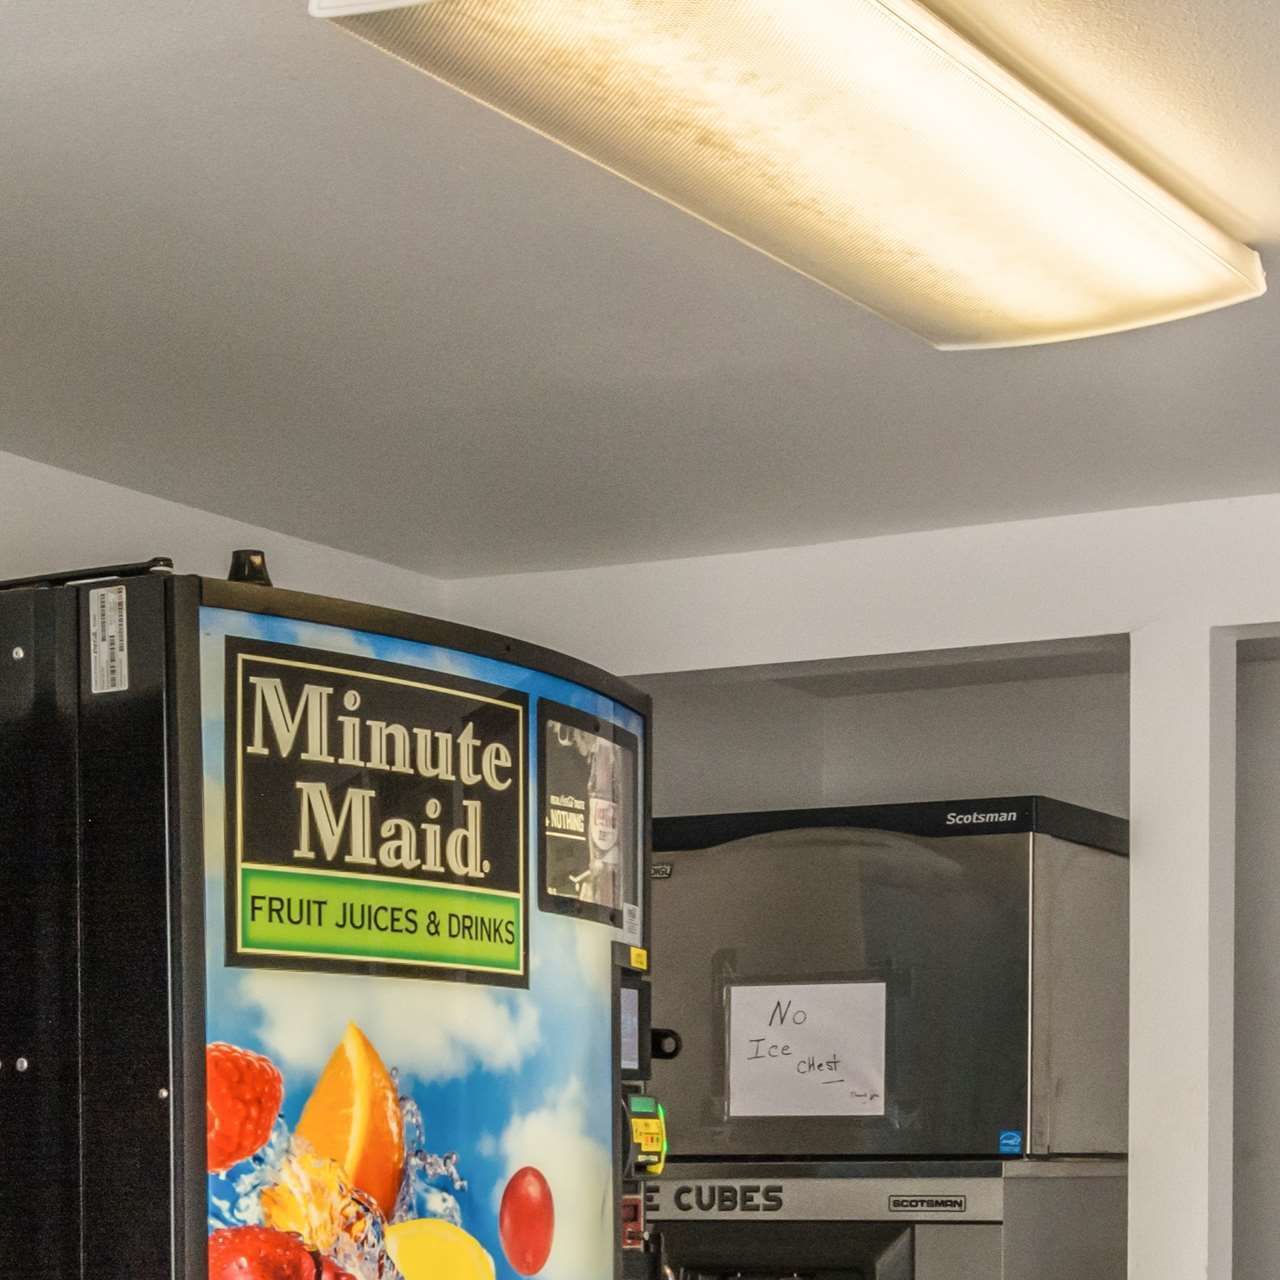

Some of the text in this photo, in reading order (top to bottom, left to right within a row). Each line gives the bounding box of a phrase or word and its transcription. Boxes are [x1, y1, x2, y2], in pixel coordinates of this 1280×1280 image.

[246, 676, 513, 791] Minute
[550, 808, 585, 833] NOTHING
[946, 811, 1017, 825] Scotsman
[249, 895, 516, 946] FRUIT JUICES & DRINKS
[768, 999, 808, 1027] No
[747, 1038, 793, 1060] Ice
[673, 1184, 784, 1212] CUBES
[892, 1199, 963, 1209] SCOTSMAN
